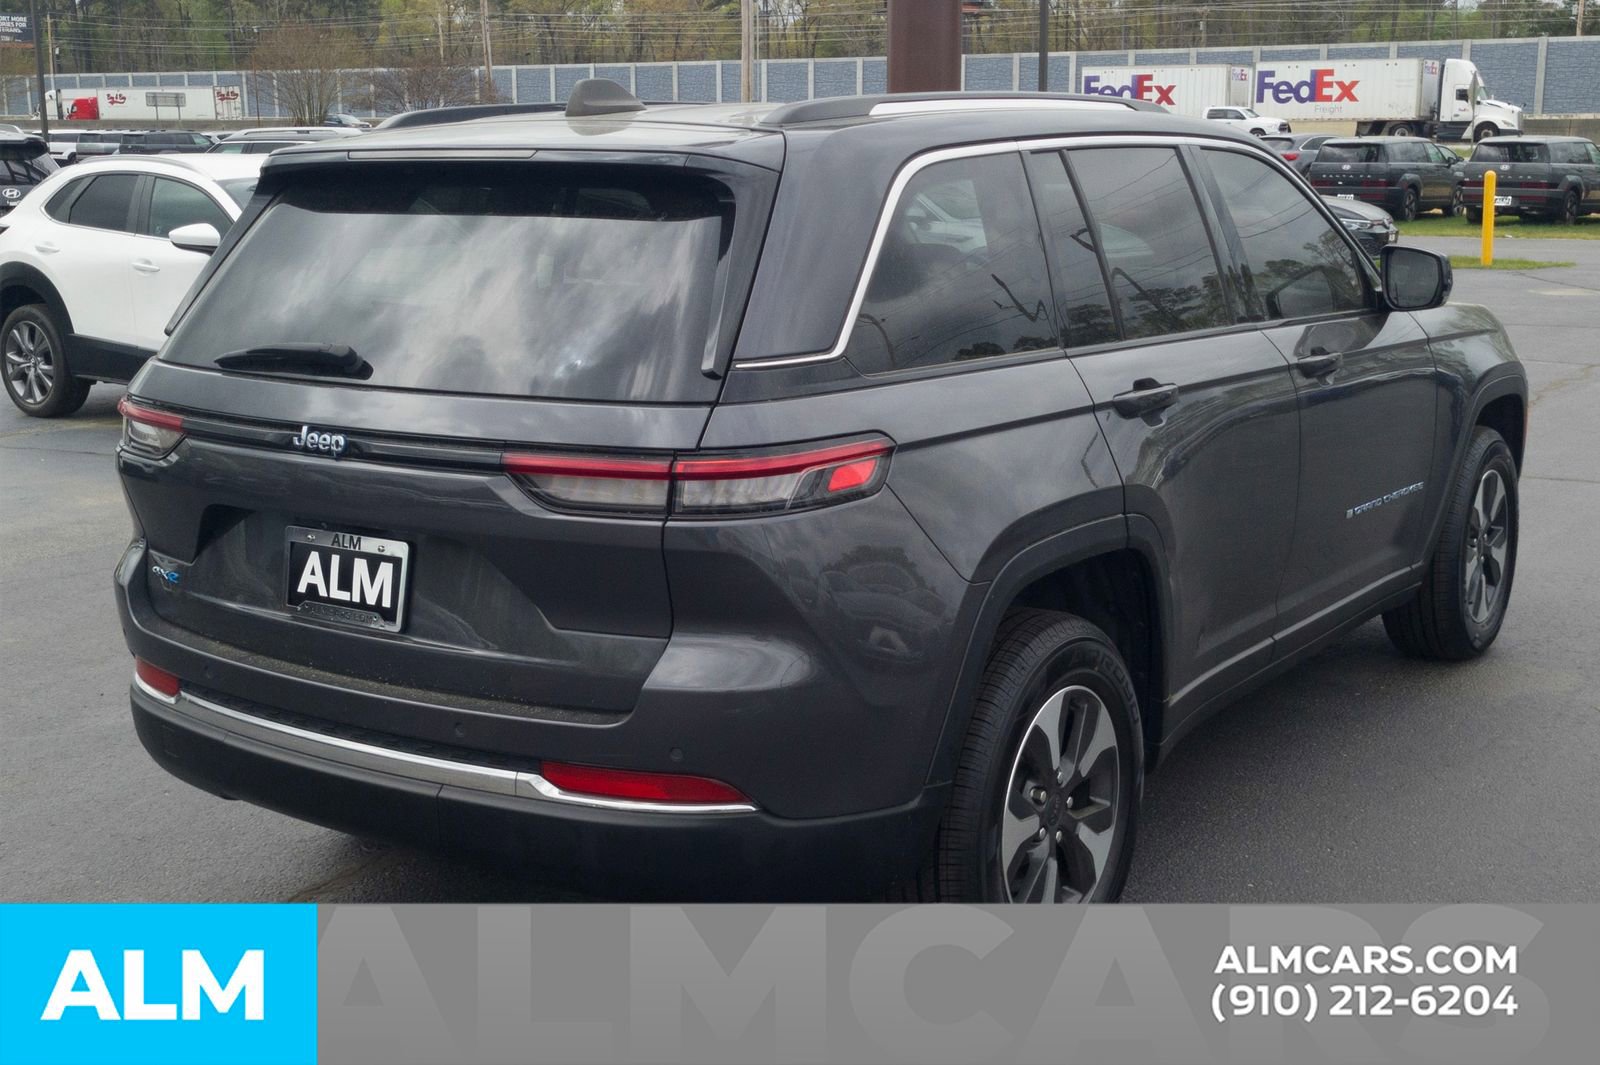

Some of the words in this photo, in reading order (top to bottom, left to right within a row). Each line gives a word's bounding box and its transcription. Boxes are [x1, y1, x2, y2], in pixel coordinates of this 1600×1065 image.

[1256, 68, 1360, 104] FedEx
[1314, 104, 1343, 114] Freight
[293, 425, 345, 458] Jeep
[331, 533, 362, 550] ALM
[297, 551, 393, 608] ALM
